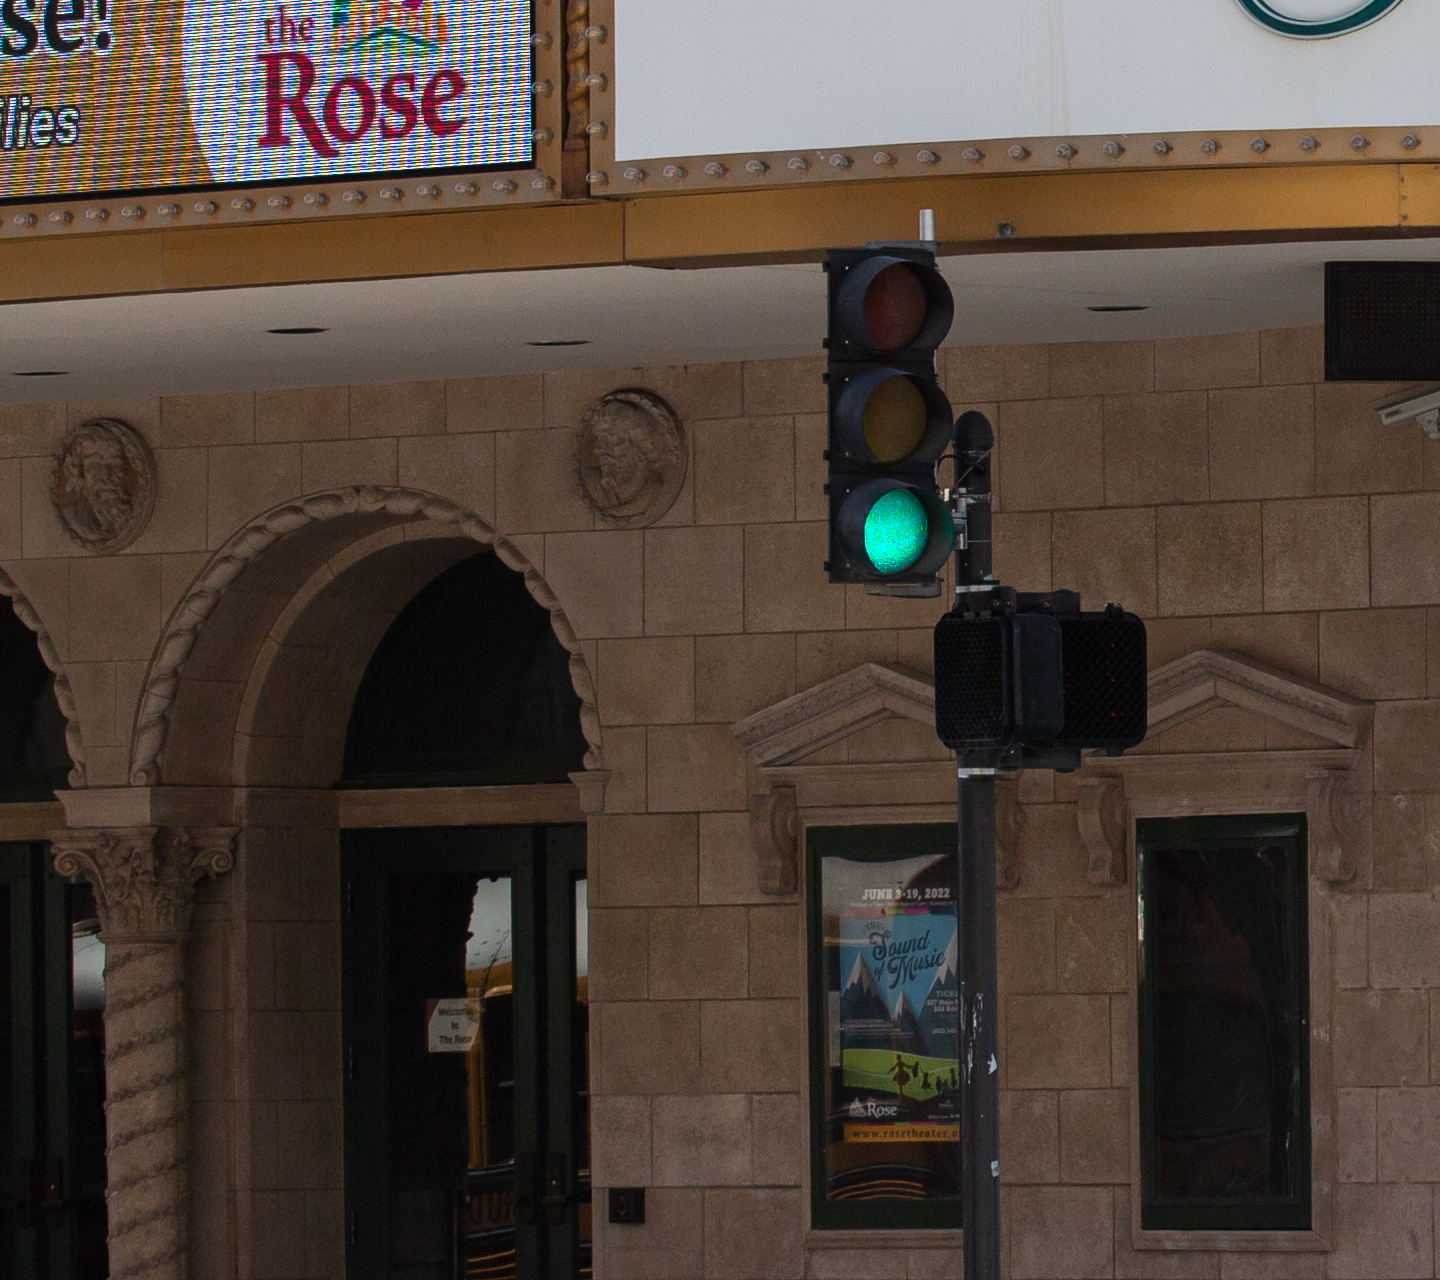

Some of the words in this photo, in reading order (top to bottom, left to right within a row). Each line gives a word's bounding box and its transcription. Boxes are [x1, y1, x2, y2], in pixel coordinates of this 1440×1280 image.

[264, 6, 315, 45] the
[257, 51, 467, 159] Rose
[862, 888, 892, 900] JUNE
[924, 887, 950, 899] 2022
[868, 930, 930, 961] Sound
[873, 961, 885, 982] of
[887, 948, 944, 989] Music
[867, 1102, 897, 1118] Rose
[852, 1129, 960, 1139] www.rosetheater.o
